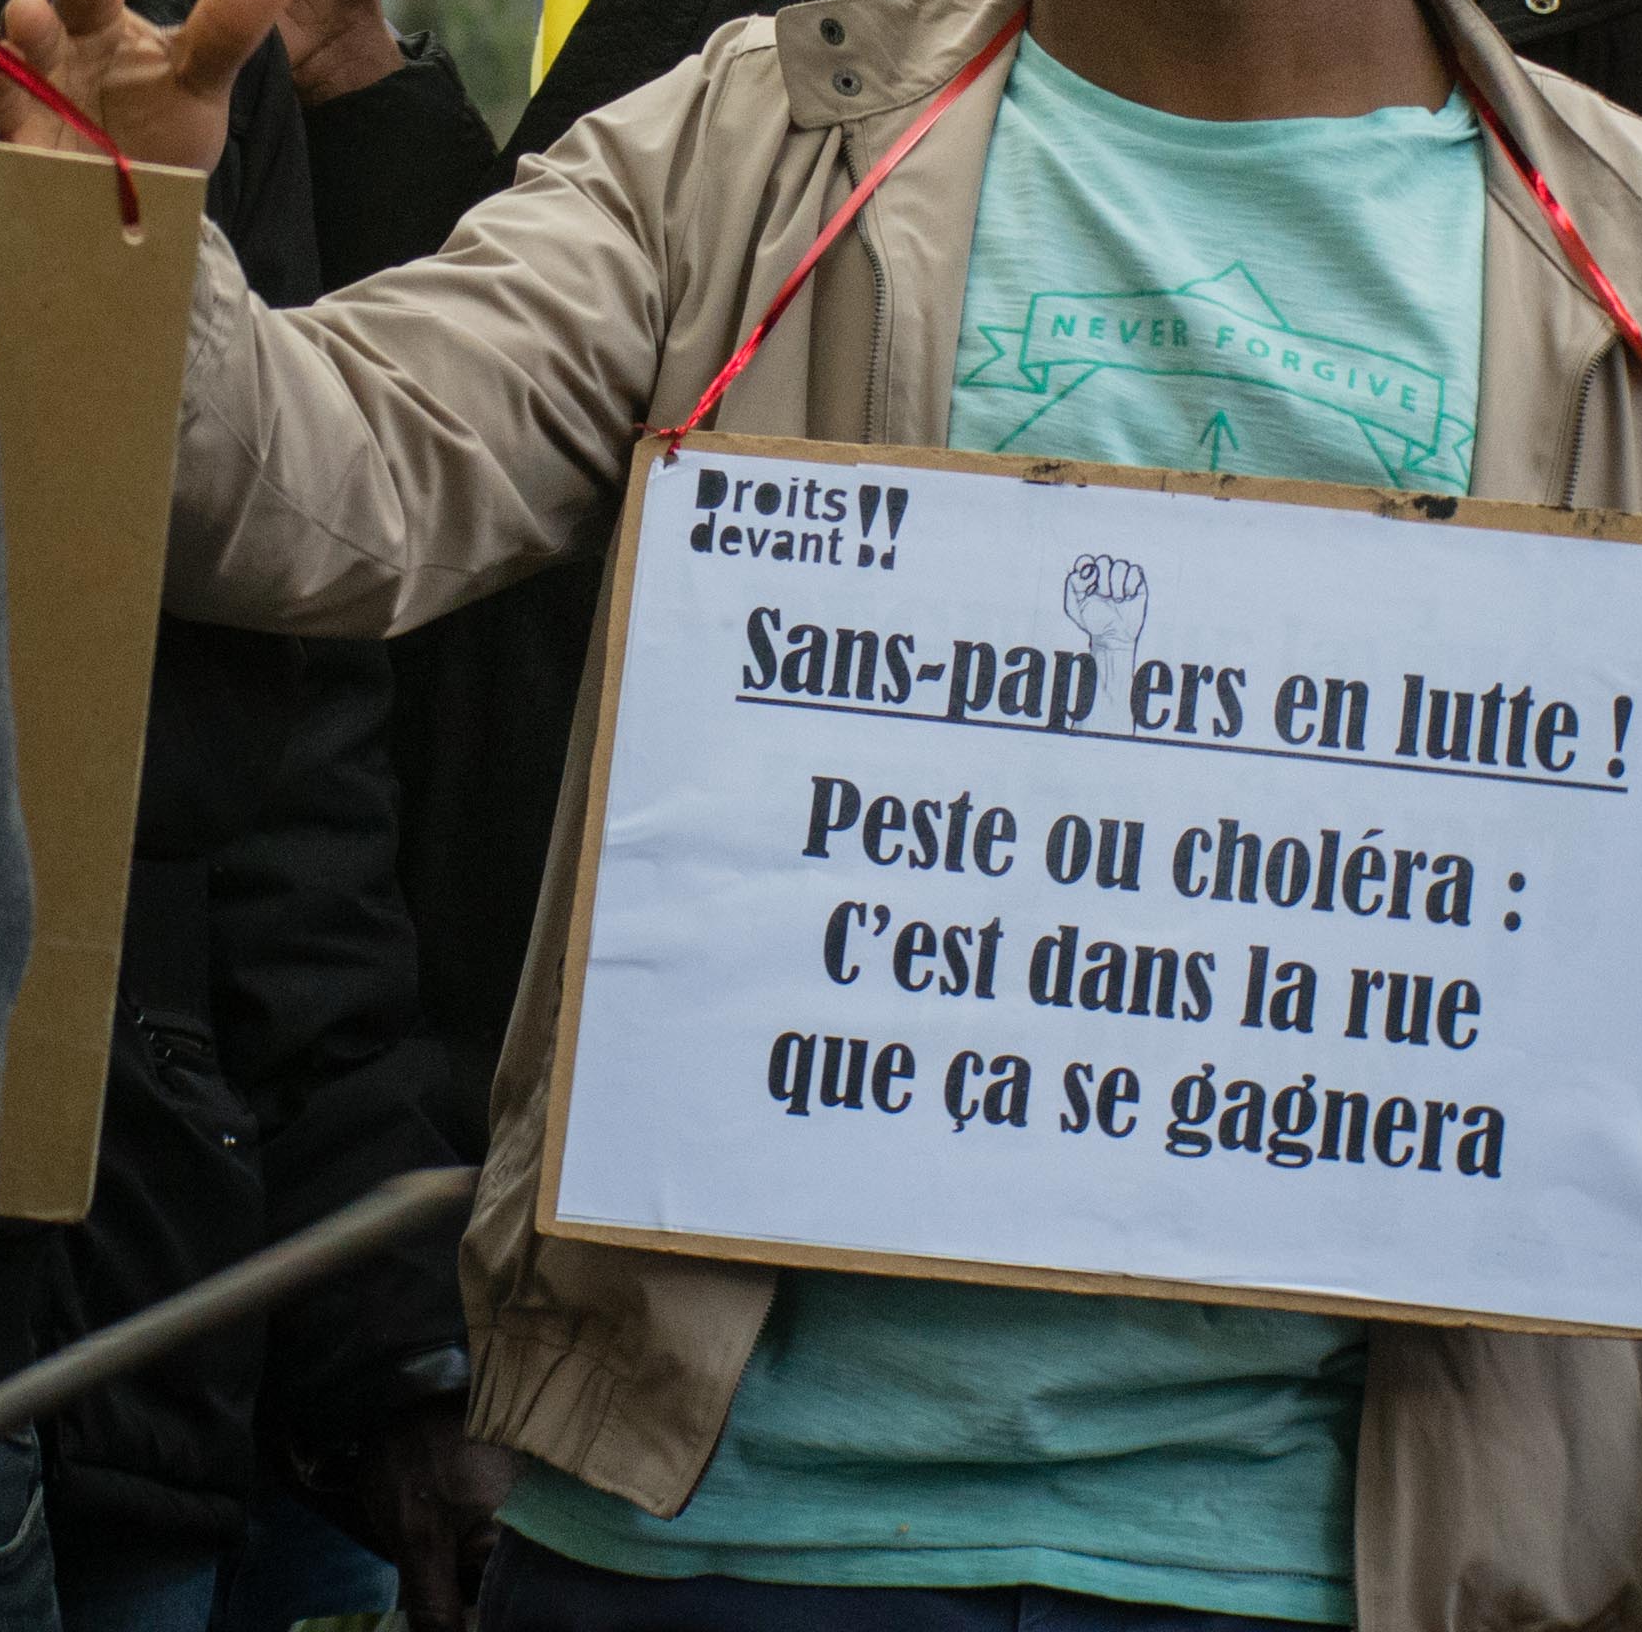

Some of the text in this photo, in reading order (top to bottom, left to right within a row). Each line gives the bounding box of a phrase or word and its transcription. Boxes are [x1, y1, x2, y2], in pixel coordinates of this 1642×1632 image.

[1050, 313, 1419, 413] NEVER FORGIVE
[690, 511, 844, 566] devant
[695, 468, 848, 523] Droits
[1274, 674, 1369, 751] en
[1395, 674, 1579, 773] lutte
[802, 776, 1017, 877] Peste
[1045, 814, 1145, 892] ou
[1172, 818, 1474, 927] choléra
[1029, 925, 1216, 1023] dans
[1240, 945, 1317, 1034] la
[1344, 968, 1481, 1050] rue
[768, 1031, 1505, 1179] que ça se gagnera
